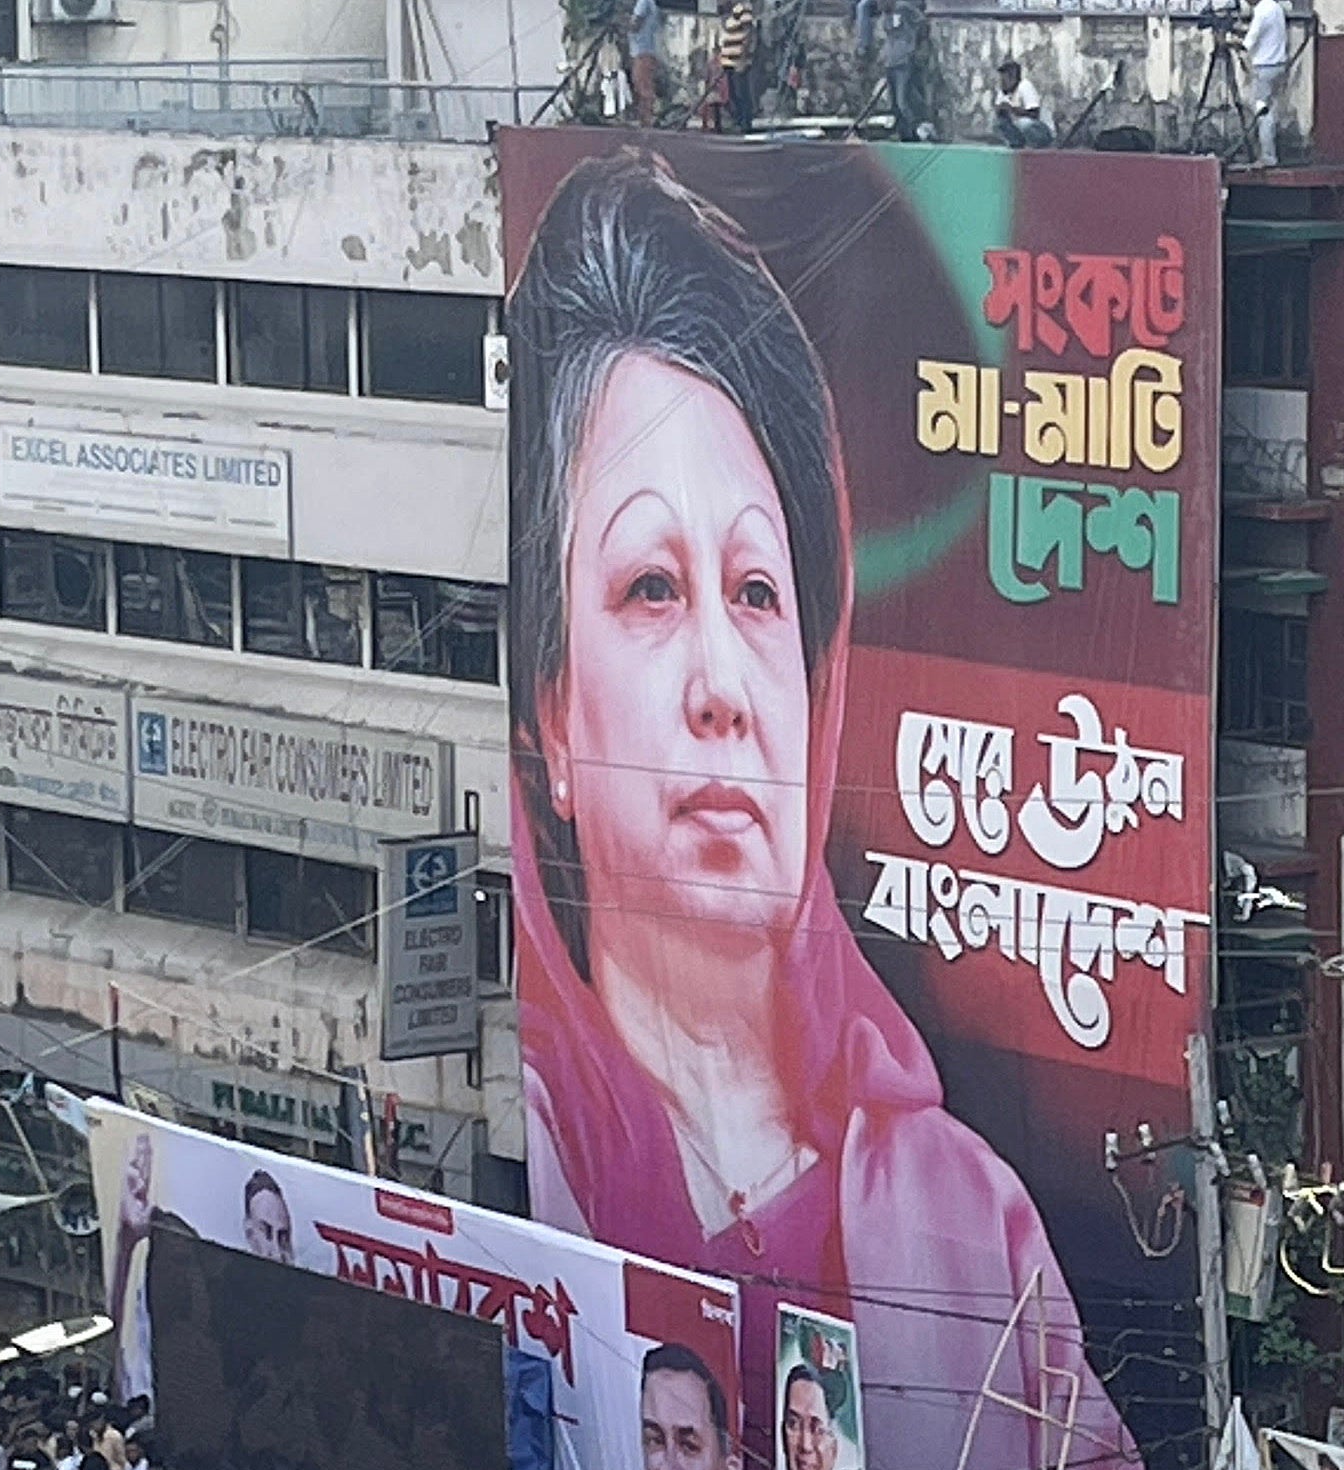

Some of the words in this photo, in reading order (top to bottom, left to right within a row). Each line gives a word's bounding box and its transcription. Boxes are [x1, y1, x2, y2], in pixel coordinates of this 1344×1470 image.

[983, 234, 1185, 357] সংকটে
[11, 436, 73, 467] EXCEL
[76, 443, 197, 480] ASSOCIATES
[202, 456, 282, 487] LIMITED
[917, 347, 1184, 473] মা-মাটি
[989, 472, 1181, 604] দেশ
[171, 717, 237, 786] ELECTRO
[240, 726, 274, 790] FAIR
[276, 732, 369, 808] CONSUMERS
[373, 751, 434, 817] LIMITED
[896, 711, 1015, 855] সেরে
[1018, 693, 1185, 869] উঠুন
[403, 925, 464, 951] ELECTRO
[862, 851, 1211, 1049] বাংলাদেশ
